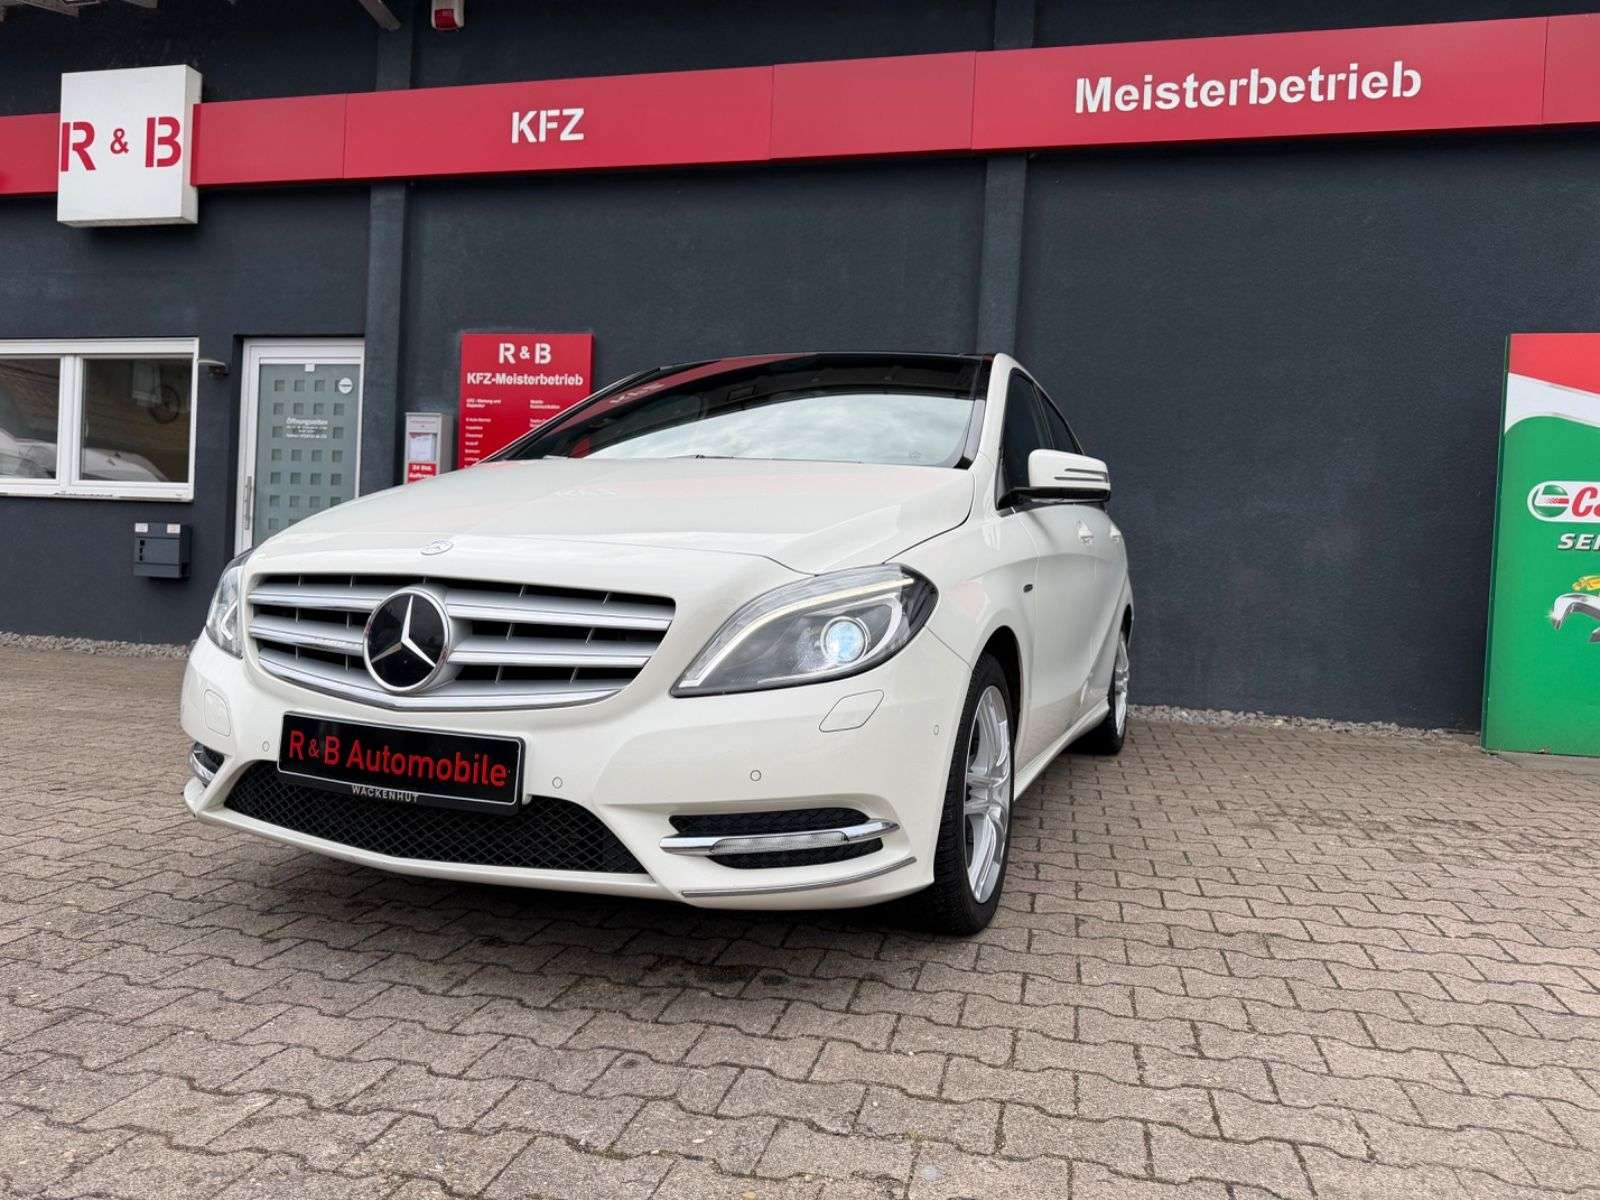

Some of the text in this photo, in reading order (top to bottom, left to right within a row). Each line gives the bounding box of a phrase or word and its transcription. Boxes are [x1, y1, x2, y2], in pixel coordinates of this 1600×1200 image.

[511, 60, 1422, 144] KFZ Meisterbetrieb
[60, 116, 182, 172] R & B
[498, 343, 552, 364] R & B
[466, 372, 584, 387] KFZ-Meisterbetrieb
[1557, 532, 1600, 550] SE
[289, 730, 508, 788] R & B Automobile
[351, 784, 420, 803] WACKENHUT
